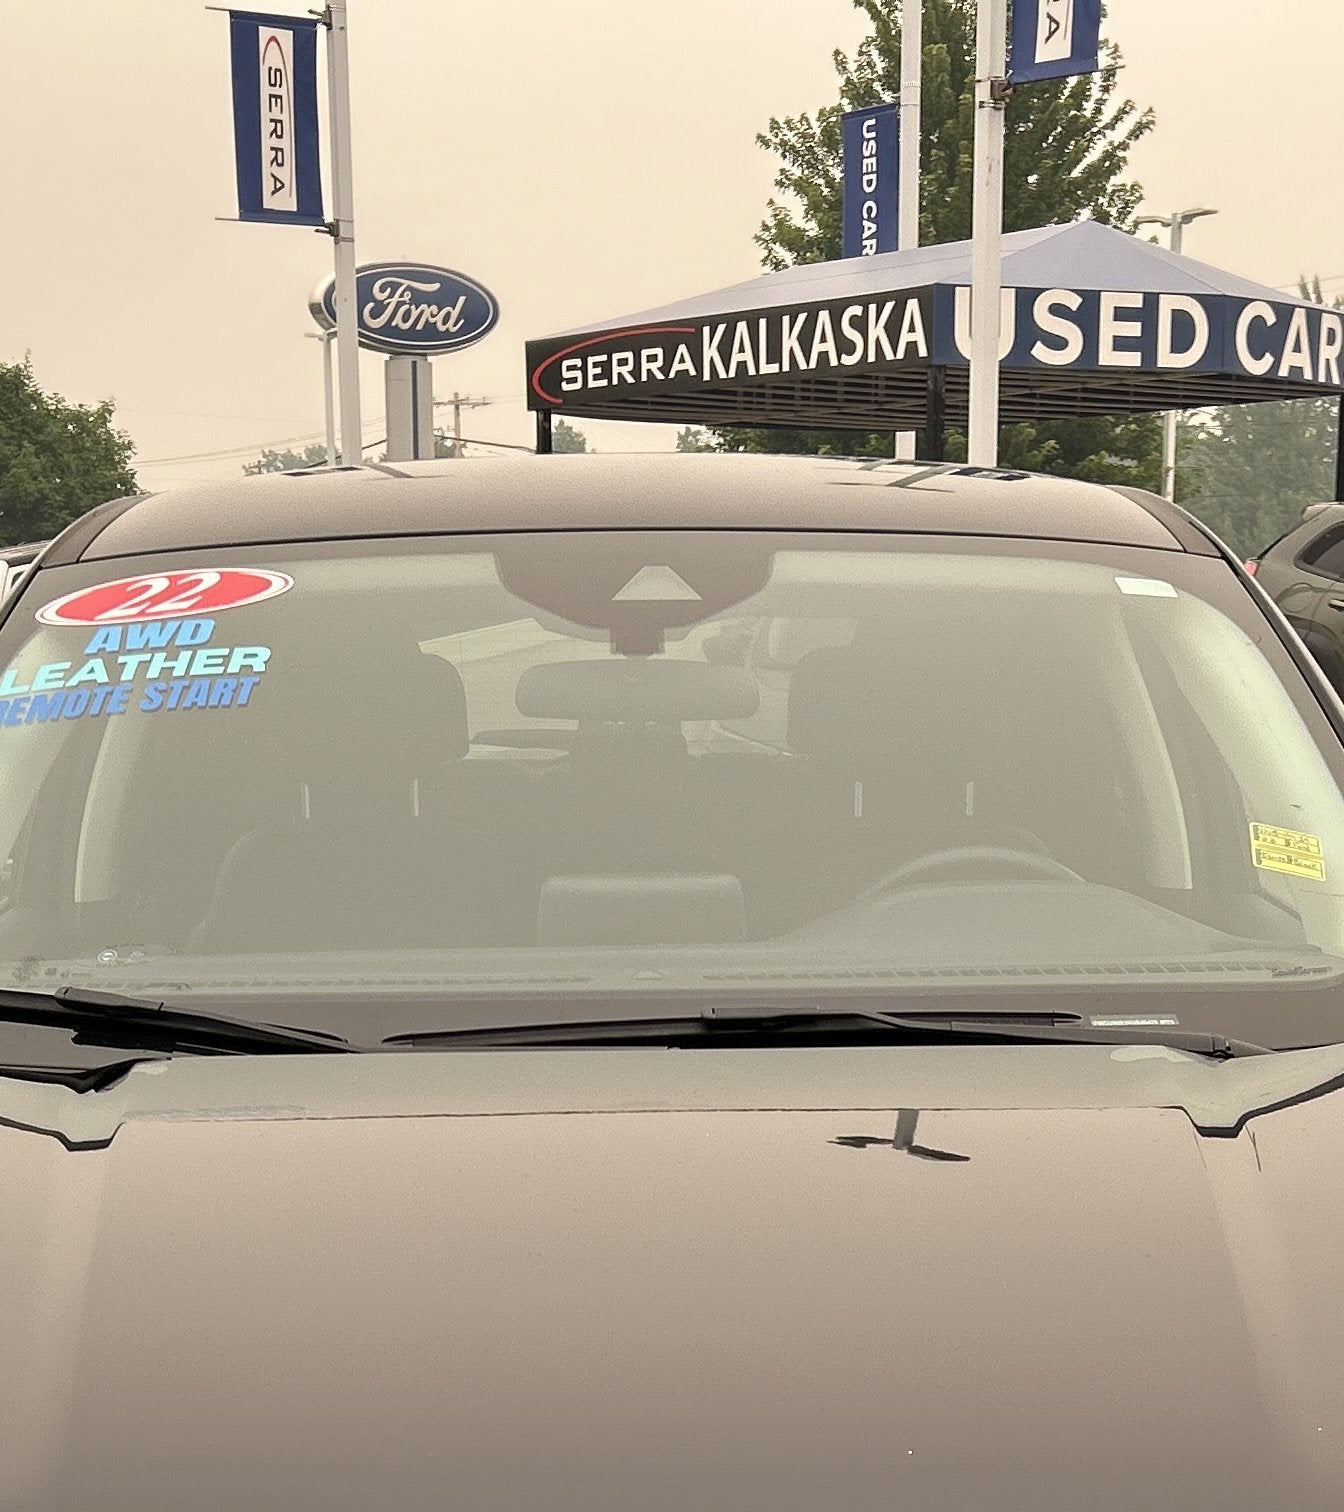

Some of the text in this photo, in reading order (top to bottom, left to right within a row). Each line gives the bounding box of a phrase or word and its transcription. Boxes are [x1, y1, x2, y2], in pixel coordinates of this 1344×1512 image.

[267, 66, 285, 197] SERRA
[862, 118, 878, 256] USED CAR
[362, 276, 467, 333] Ford
[954, 285, 1210, 369] USED
[560, 297, 929, 392] SERRA KALKASKA
[94, 571, 221, 621] 22
[85, 619, 217, 655] AWD
[139, 676, 262, 712] START
